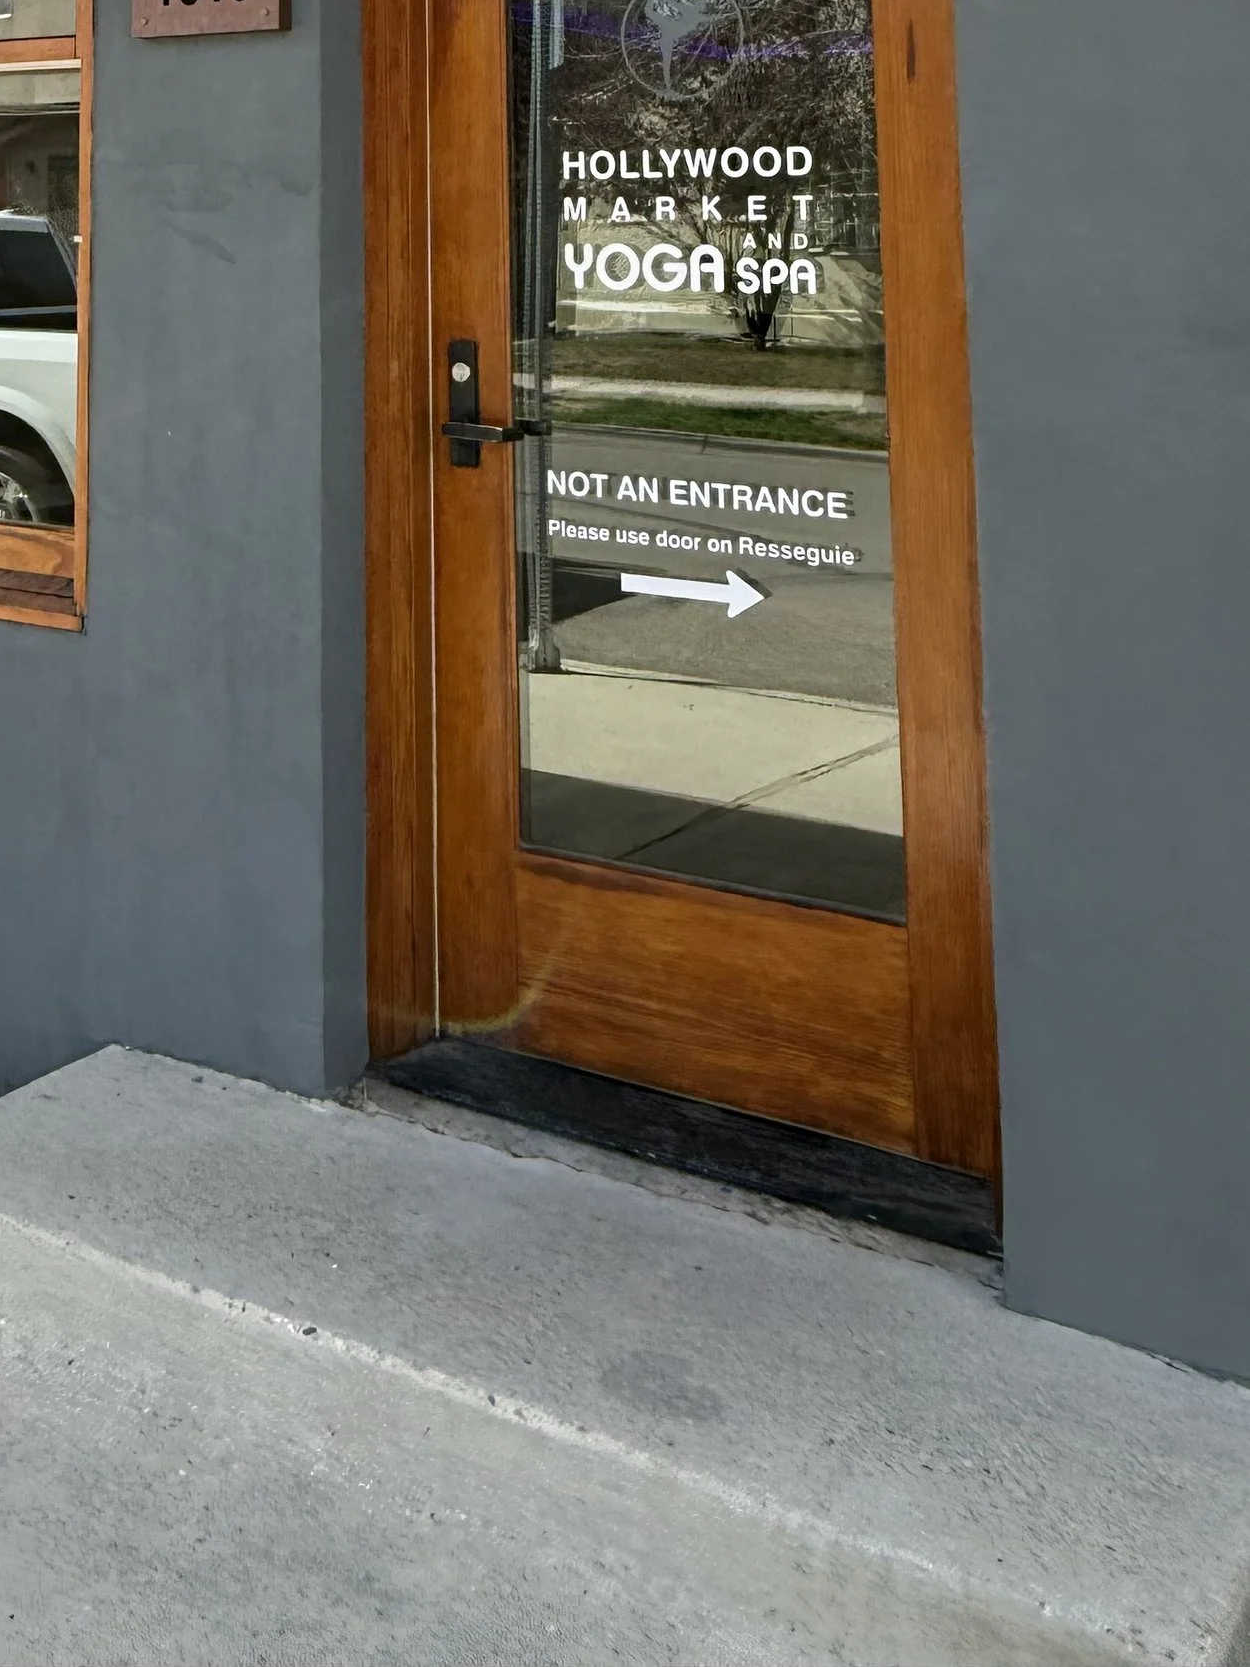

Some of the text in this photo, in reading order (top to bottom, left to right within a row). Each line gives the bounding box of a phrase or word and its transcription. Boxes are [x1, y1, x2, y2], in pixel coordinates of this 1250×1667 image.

[562, 146, 813, 180] HOLLYWOOD
[562, 195, 813, 221] MARKET
[742, 233, 809, 249] AND
[564, 243, 817, 295] YOGA SPA
[547, 470, 848, 520] NOT AN ENTRANCE
[549, 520, 855, 566] Please use door on Resseguie
